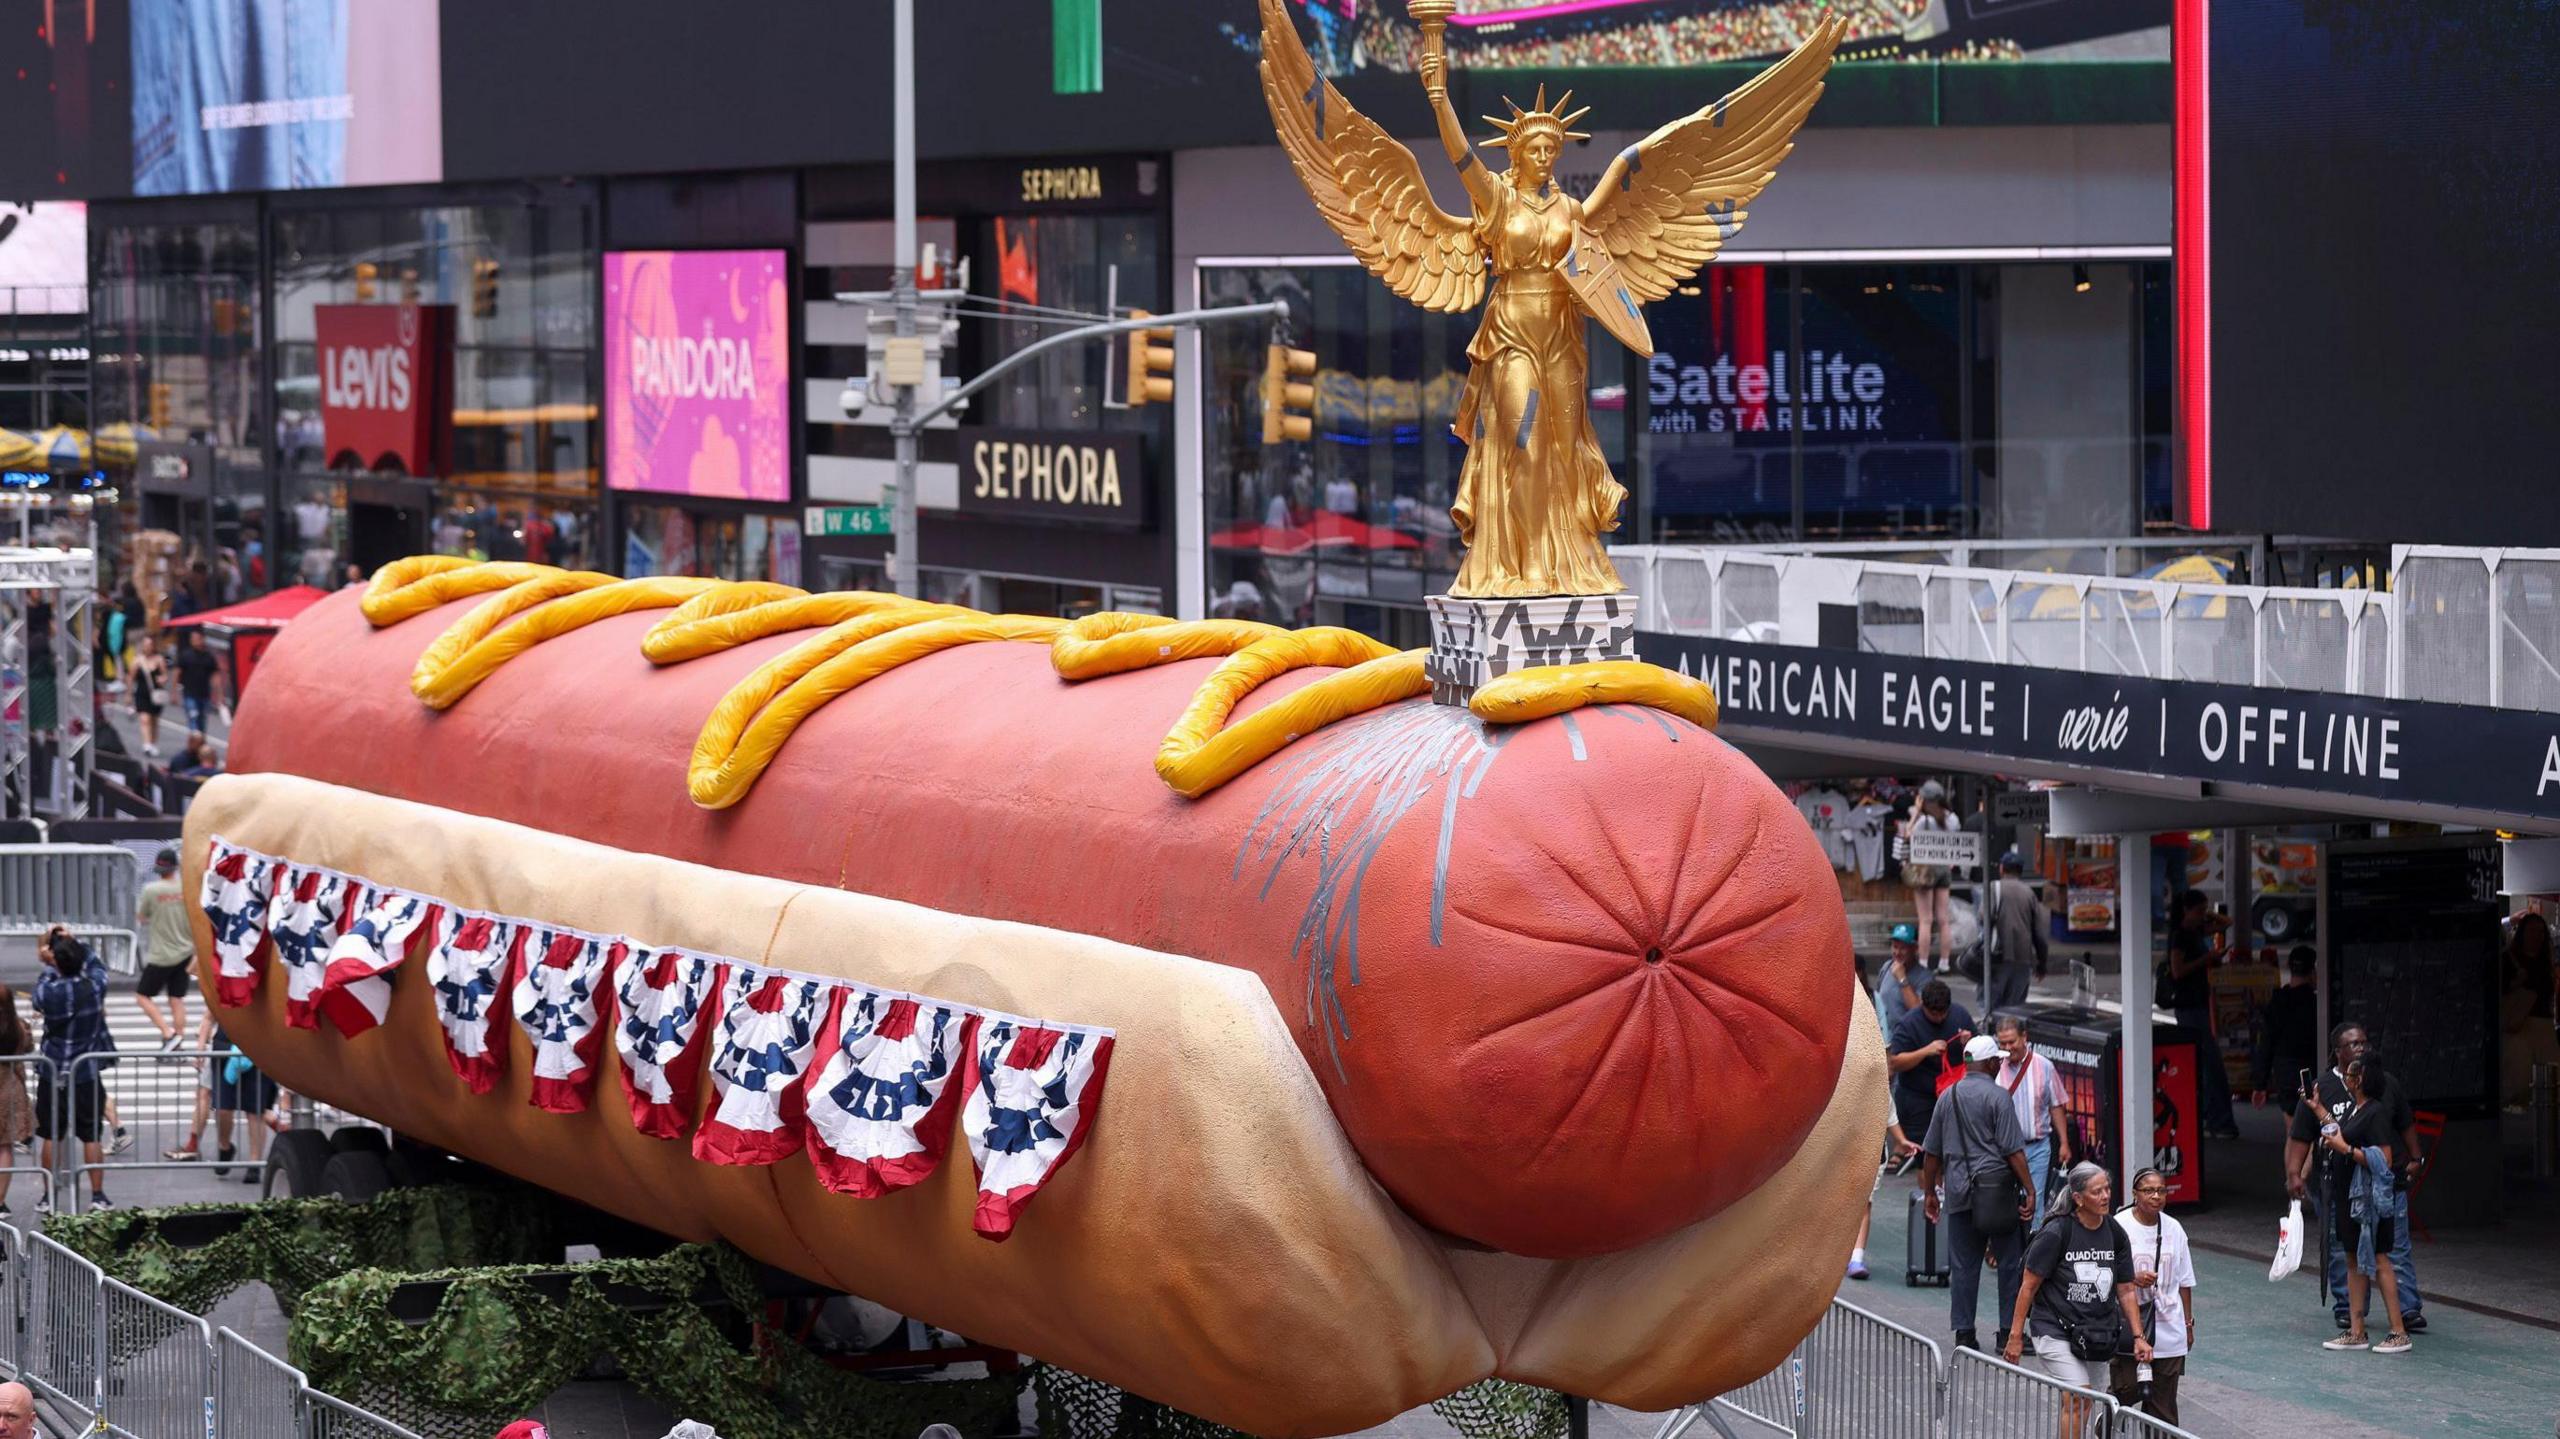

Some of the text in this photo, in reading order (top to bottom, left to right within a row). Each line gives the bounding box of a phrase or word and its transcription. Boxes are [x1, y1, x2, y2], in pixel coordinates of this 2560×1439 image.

[1022, 167, 1101, 201] SEPHORA
[632, 336, 757, 401] PANDORA
[1649, 409, 1696, 433] with
[974, 440, 1122, 507] SEPHORA
[826, 511, 843, 532] W
[850, 511, 873, 532] 46
[1677, 652, 2400, 780] AMERICAN EAGLE aerie OFFLINE
[1913, 834, 1975, 848] PEDESTRIAN FLOW ZONE
[1913, 848, 1948, 859] KEEP MOVING
[2065, 1250, 2092, 1261] QUAD
